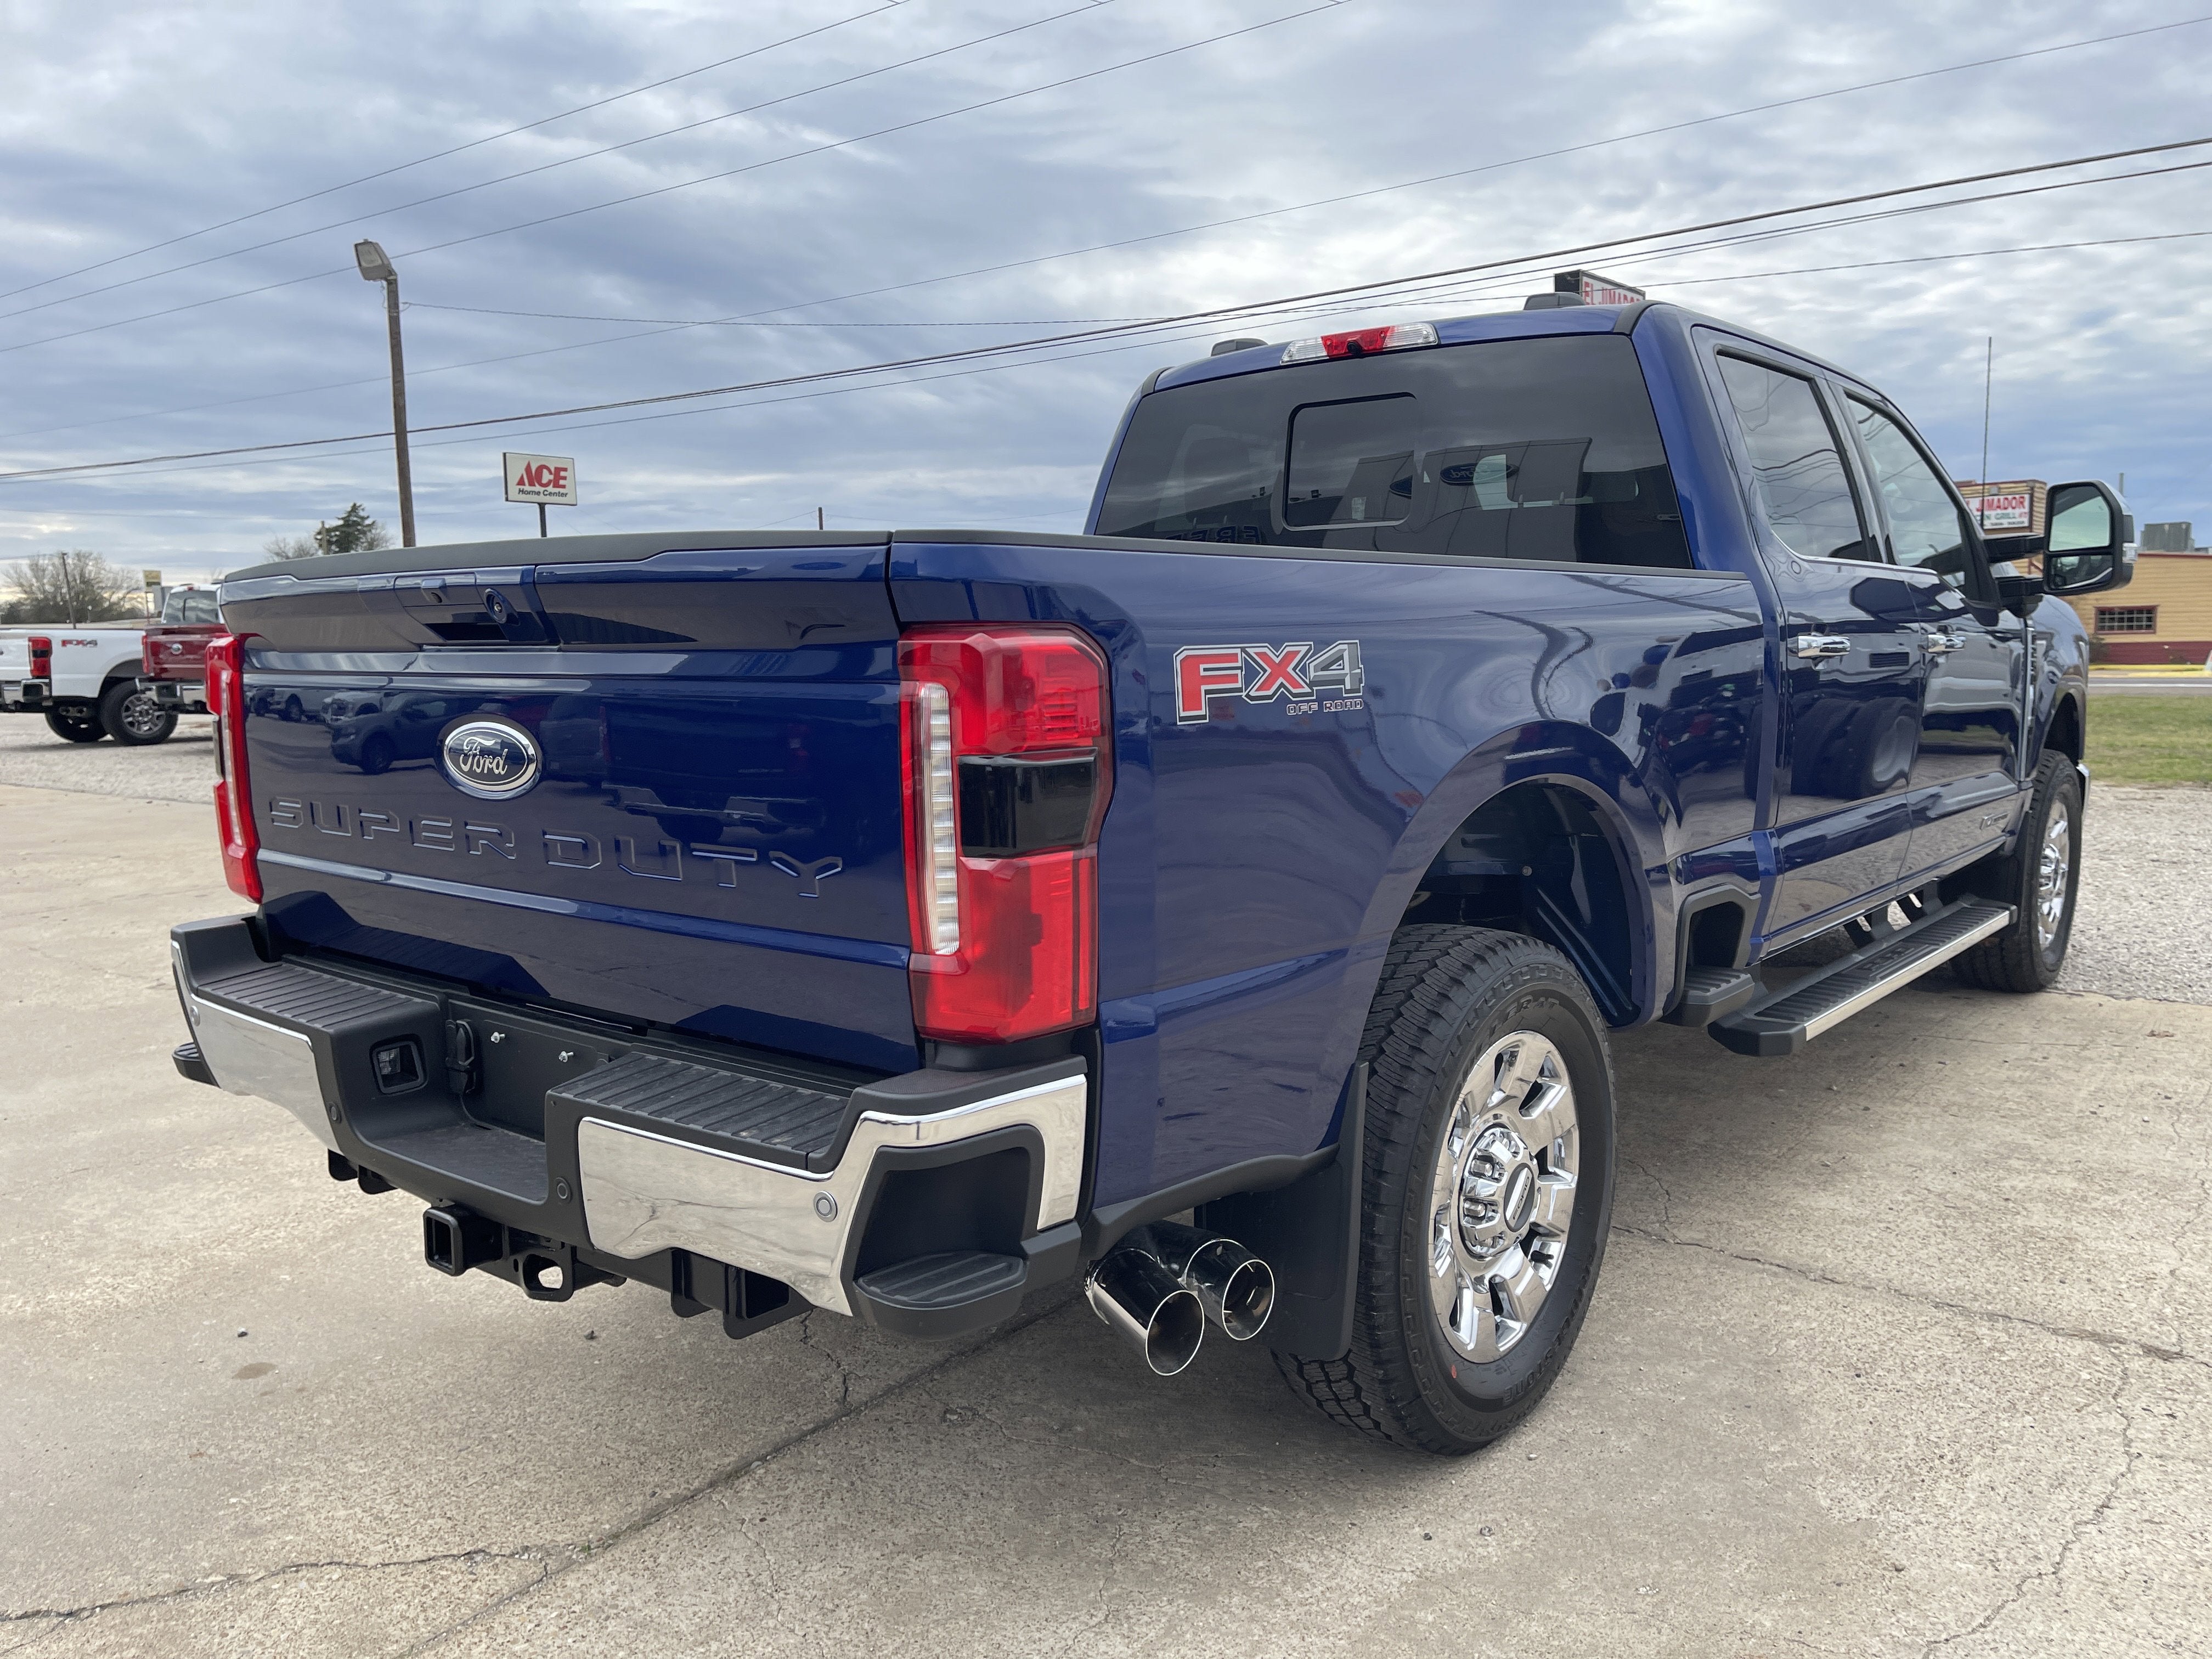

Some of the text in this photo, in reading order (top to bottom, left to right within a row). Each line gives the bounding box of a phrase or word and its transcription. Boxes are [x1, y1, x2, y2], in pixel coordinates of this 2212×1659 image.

[516, 460, 568, 489] ACE
[517, 488, 568, 498] Home Center
[61, 639, 98, 647] FX4
[1173, 640, 1365, 725] FX4
[1286, 698, 1364, 715] OFF ROAD
[459, 736, 509, 775] Ford
[269, 796, 843, 898] SUPER DUTY
[1513, 1176, 1530, 1220] FORD
